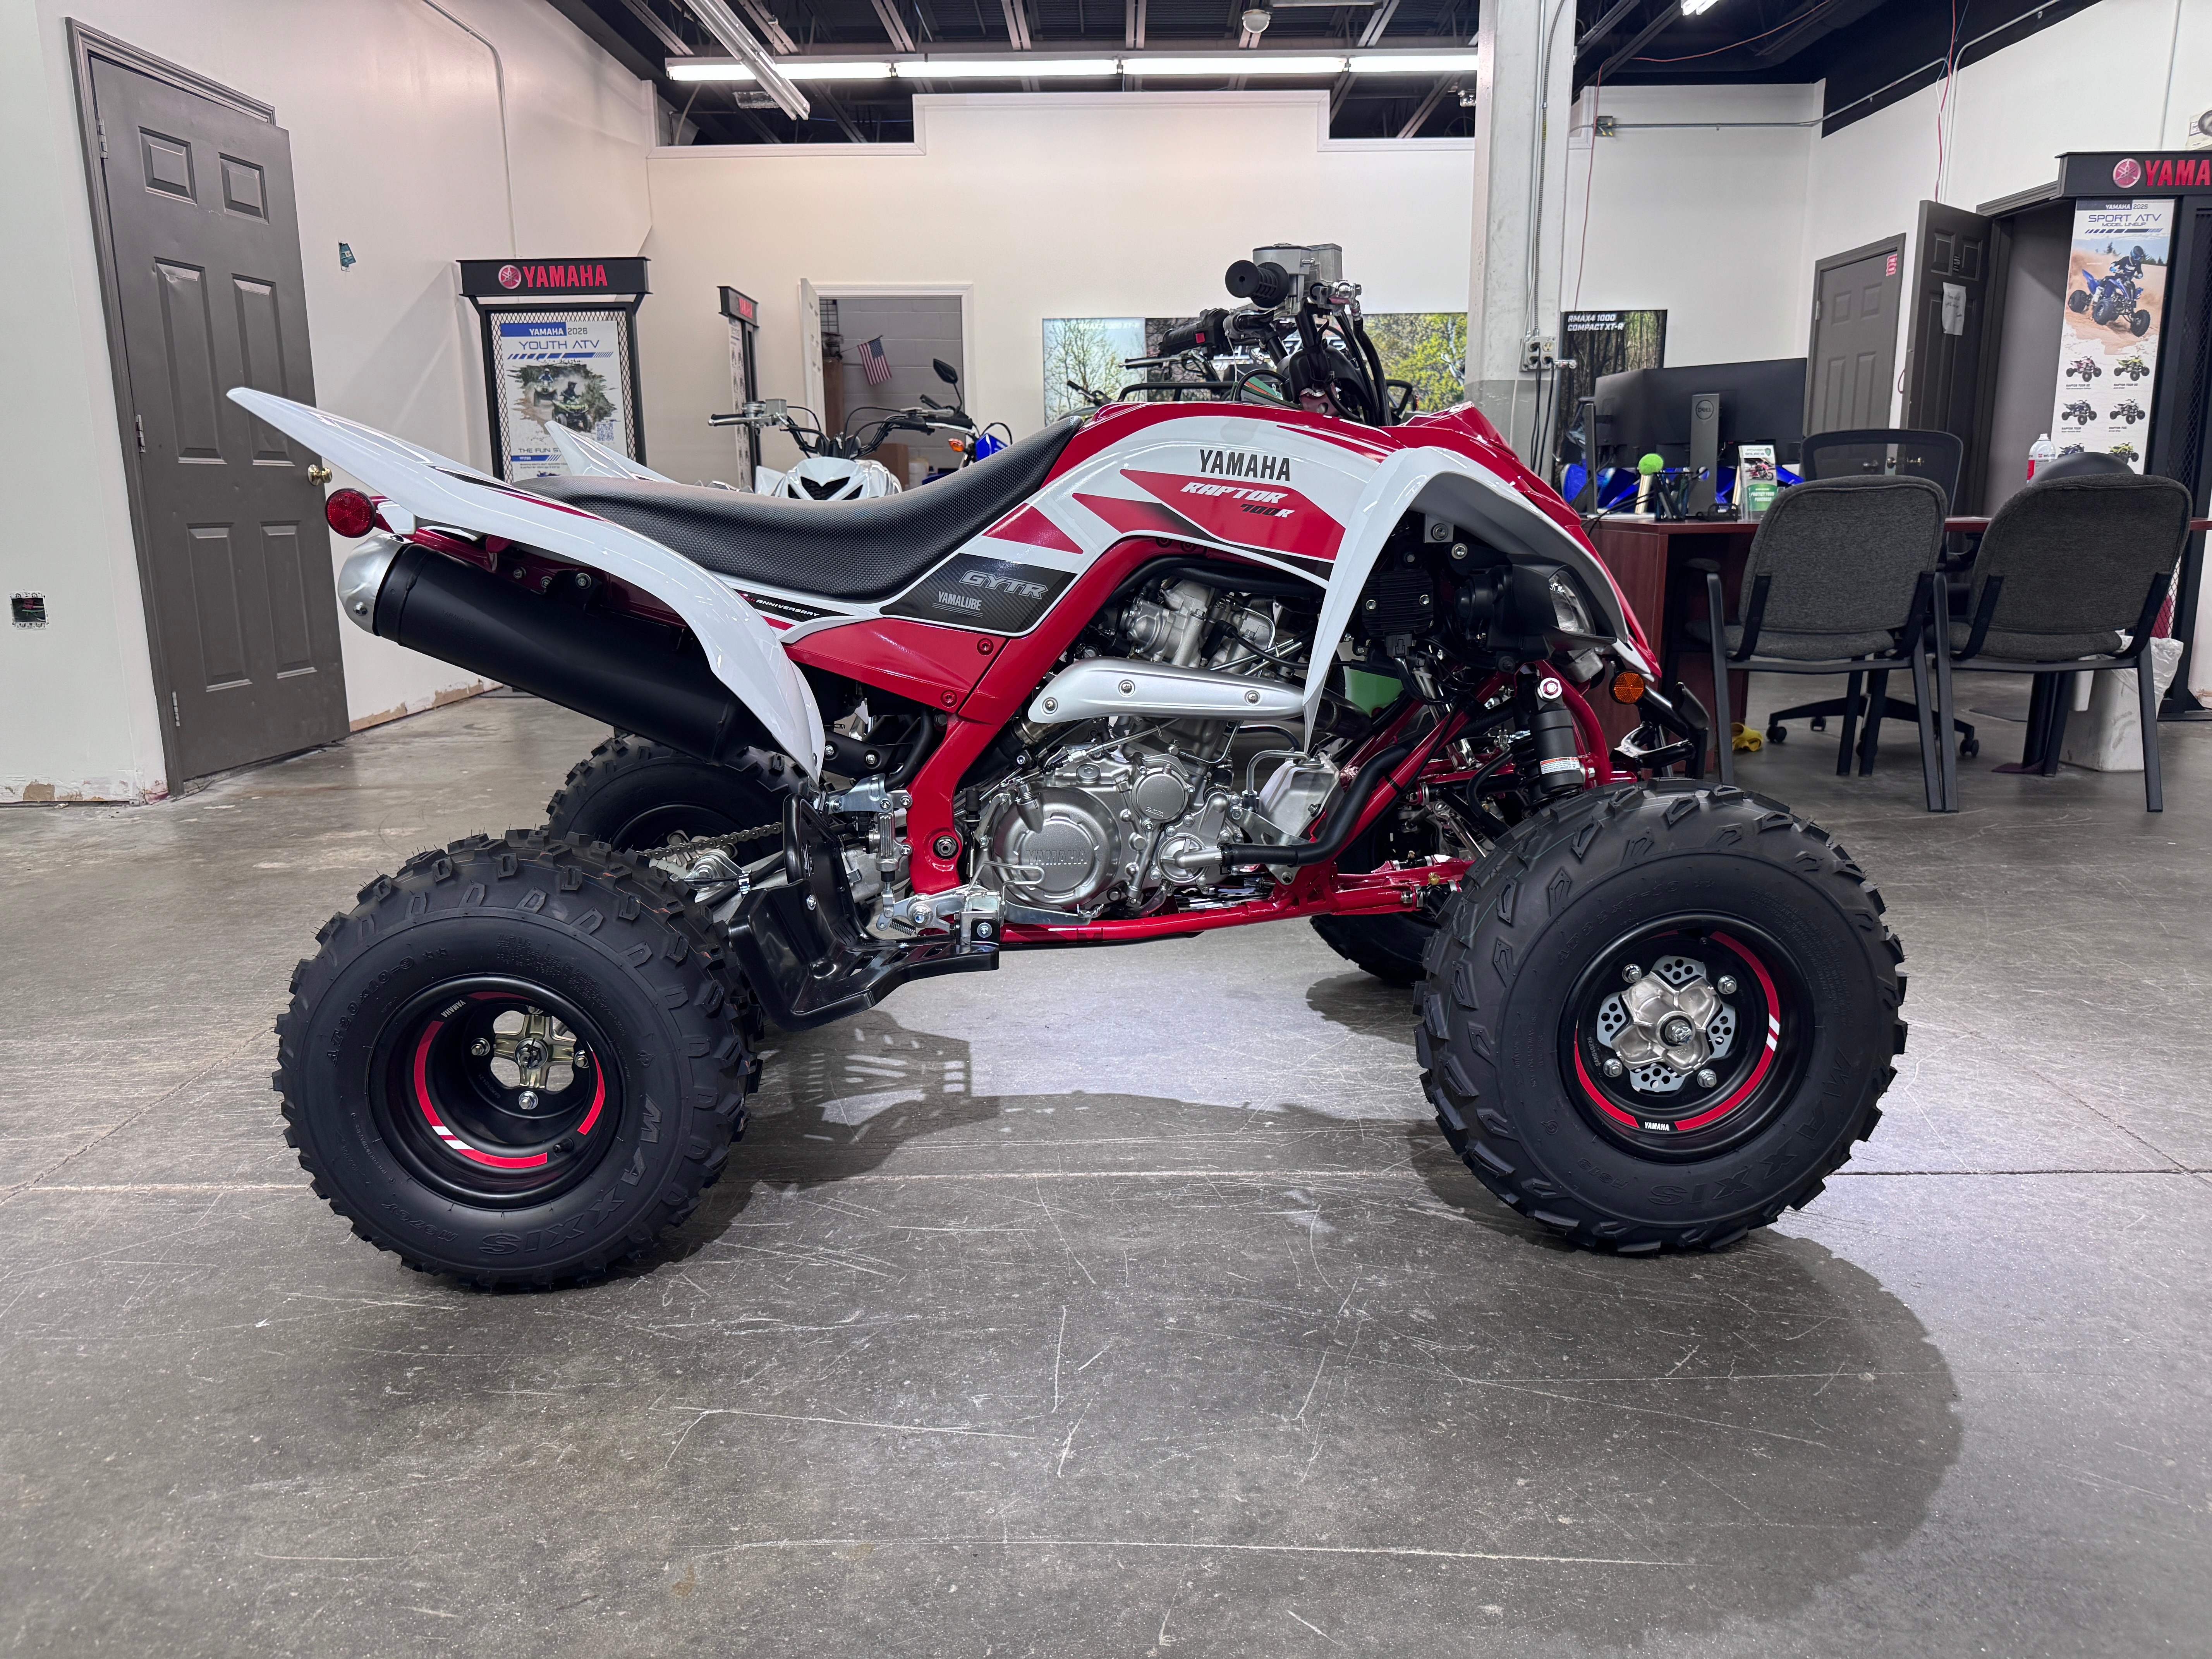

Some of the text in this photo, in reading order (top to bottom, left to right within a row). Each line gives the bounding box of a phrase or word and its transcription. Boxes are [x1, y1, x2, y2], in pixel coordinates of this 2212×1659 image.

[522, 265, 608, 288] YAMAHA
[1567, 322, 1625, 331] COMPACT XT-R
[1568, 313, 1617, 322] RMAX4 1000
[519, 339, 600, 350] YOUTH ATV
[1200, 449, 1290, 482] YAMAHA
[1180, 482, 1288, 503] RAPTOR
[1240, 503, 1295, 518] 700R
[958, 570, 1049, 600] GYTR
[756, 599, 820, 617] ANNIVERSARY
[938, 591, 982, 611] YAMALUBE
[1026, 850, 1087, 865] YAMAHA
[441, 1000, 466, 1018] YAMAHA
[1644, 1121, 1669, 1131] YAMAHA
[1648, 1046, 1852, 1205] MAXXIS
[478, 1093, 663, 1255] MAXXIS
